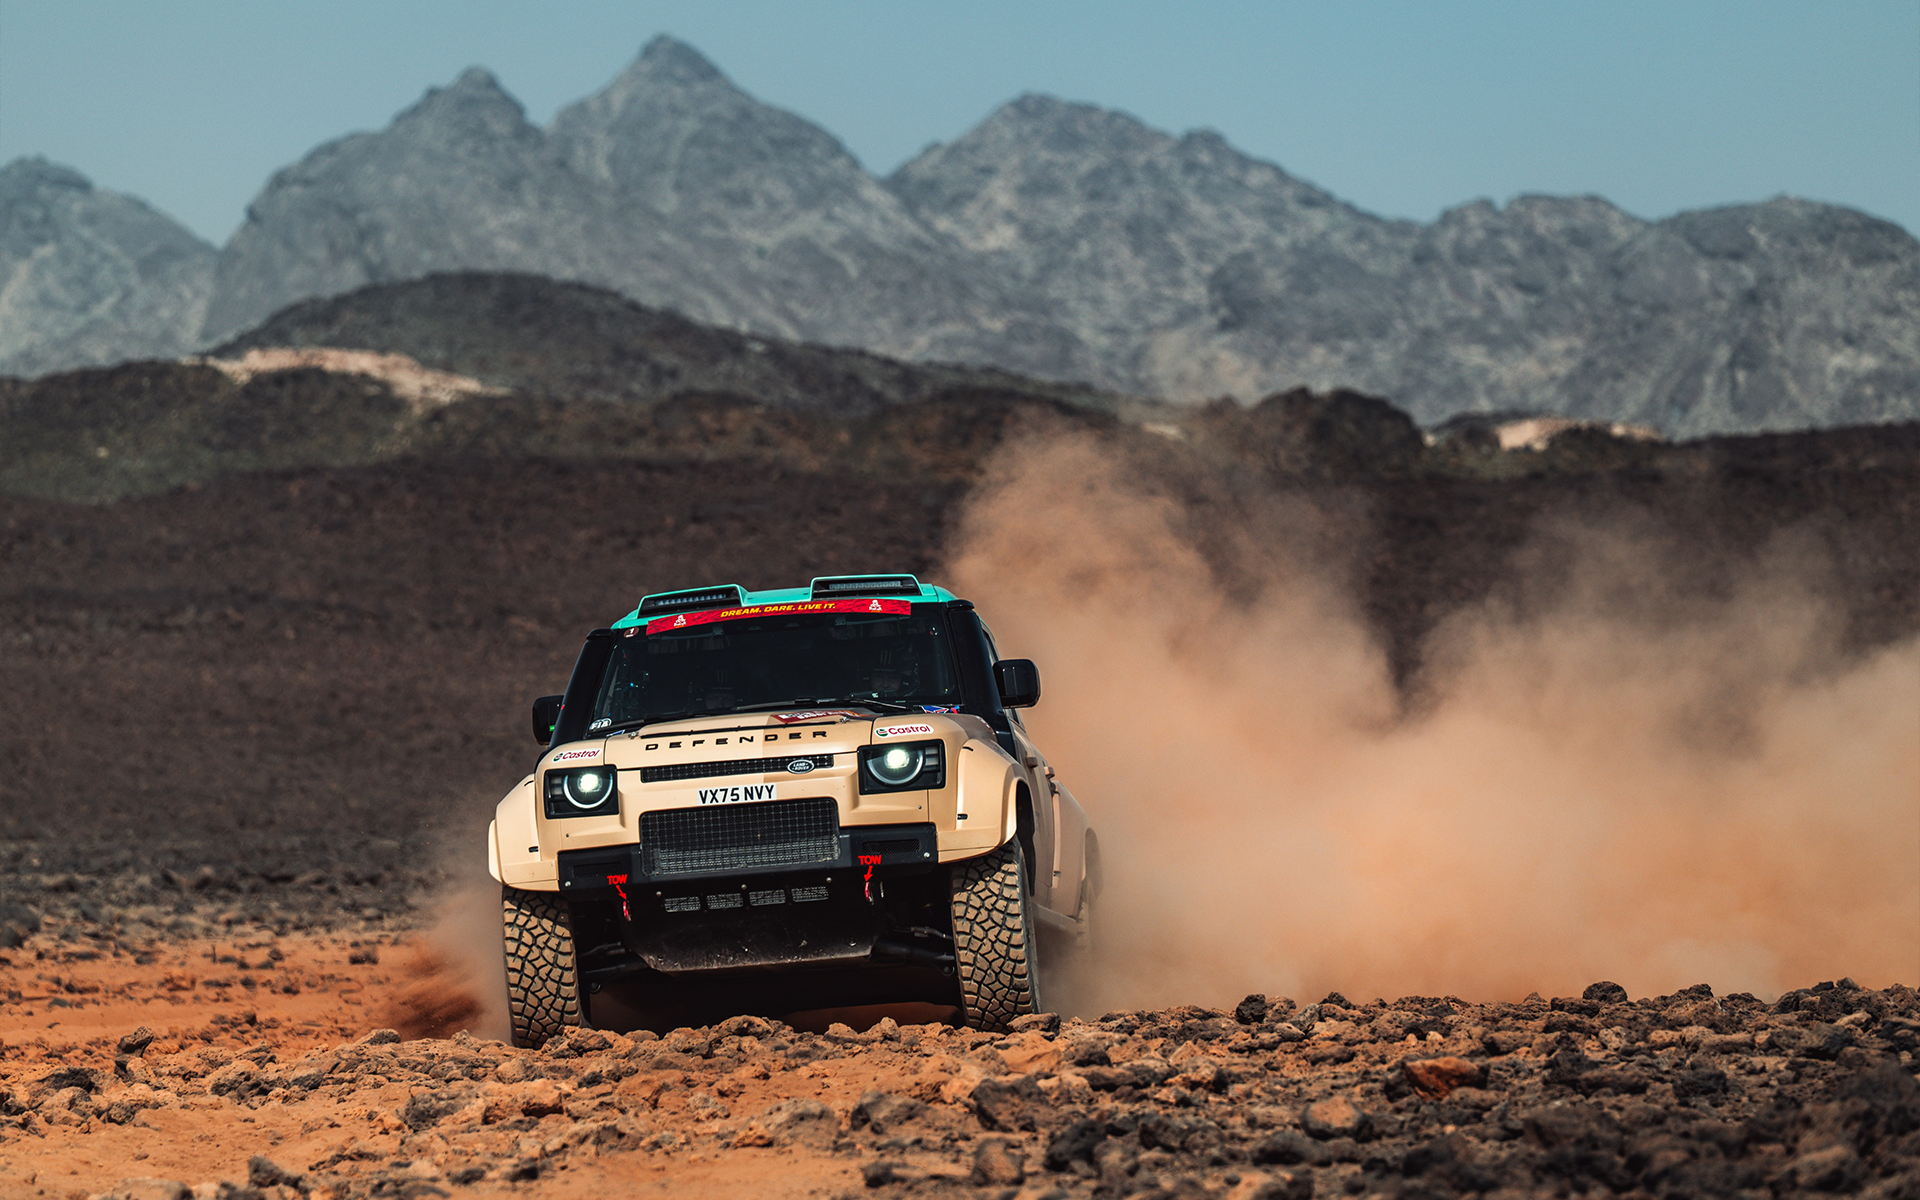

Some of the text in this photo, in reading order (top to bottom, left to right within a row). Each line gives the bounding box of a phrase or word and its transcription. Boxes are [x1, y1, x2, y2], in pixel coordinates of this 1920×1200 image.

[720, 608, 762, 617] DREAM.
[764, 604, 796, 612] DARE.
[888, 725, 931, 735] Castrol
[645, 731, 827, 751] DEFENDER
[562, 750, 601, 760] Castrol
[699, 784, 775, 805] VX75 NVY
[857, 855, 882, 865] TOW
[606, 874, 628, 885] TOW
